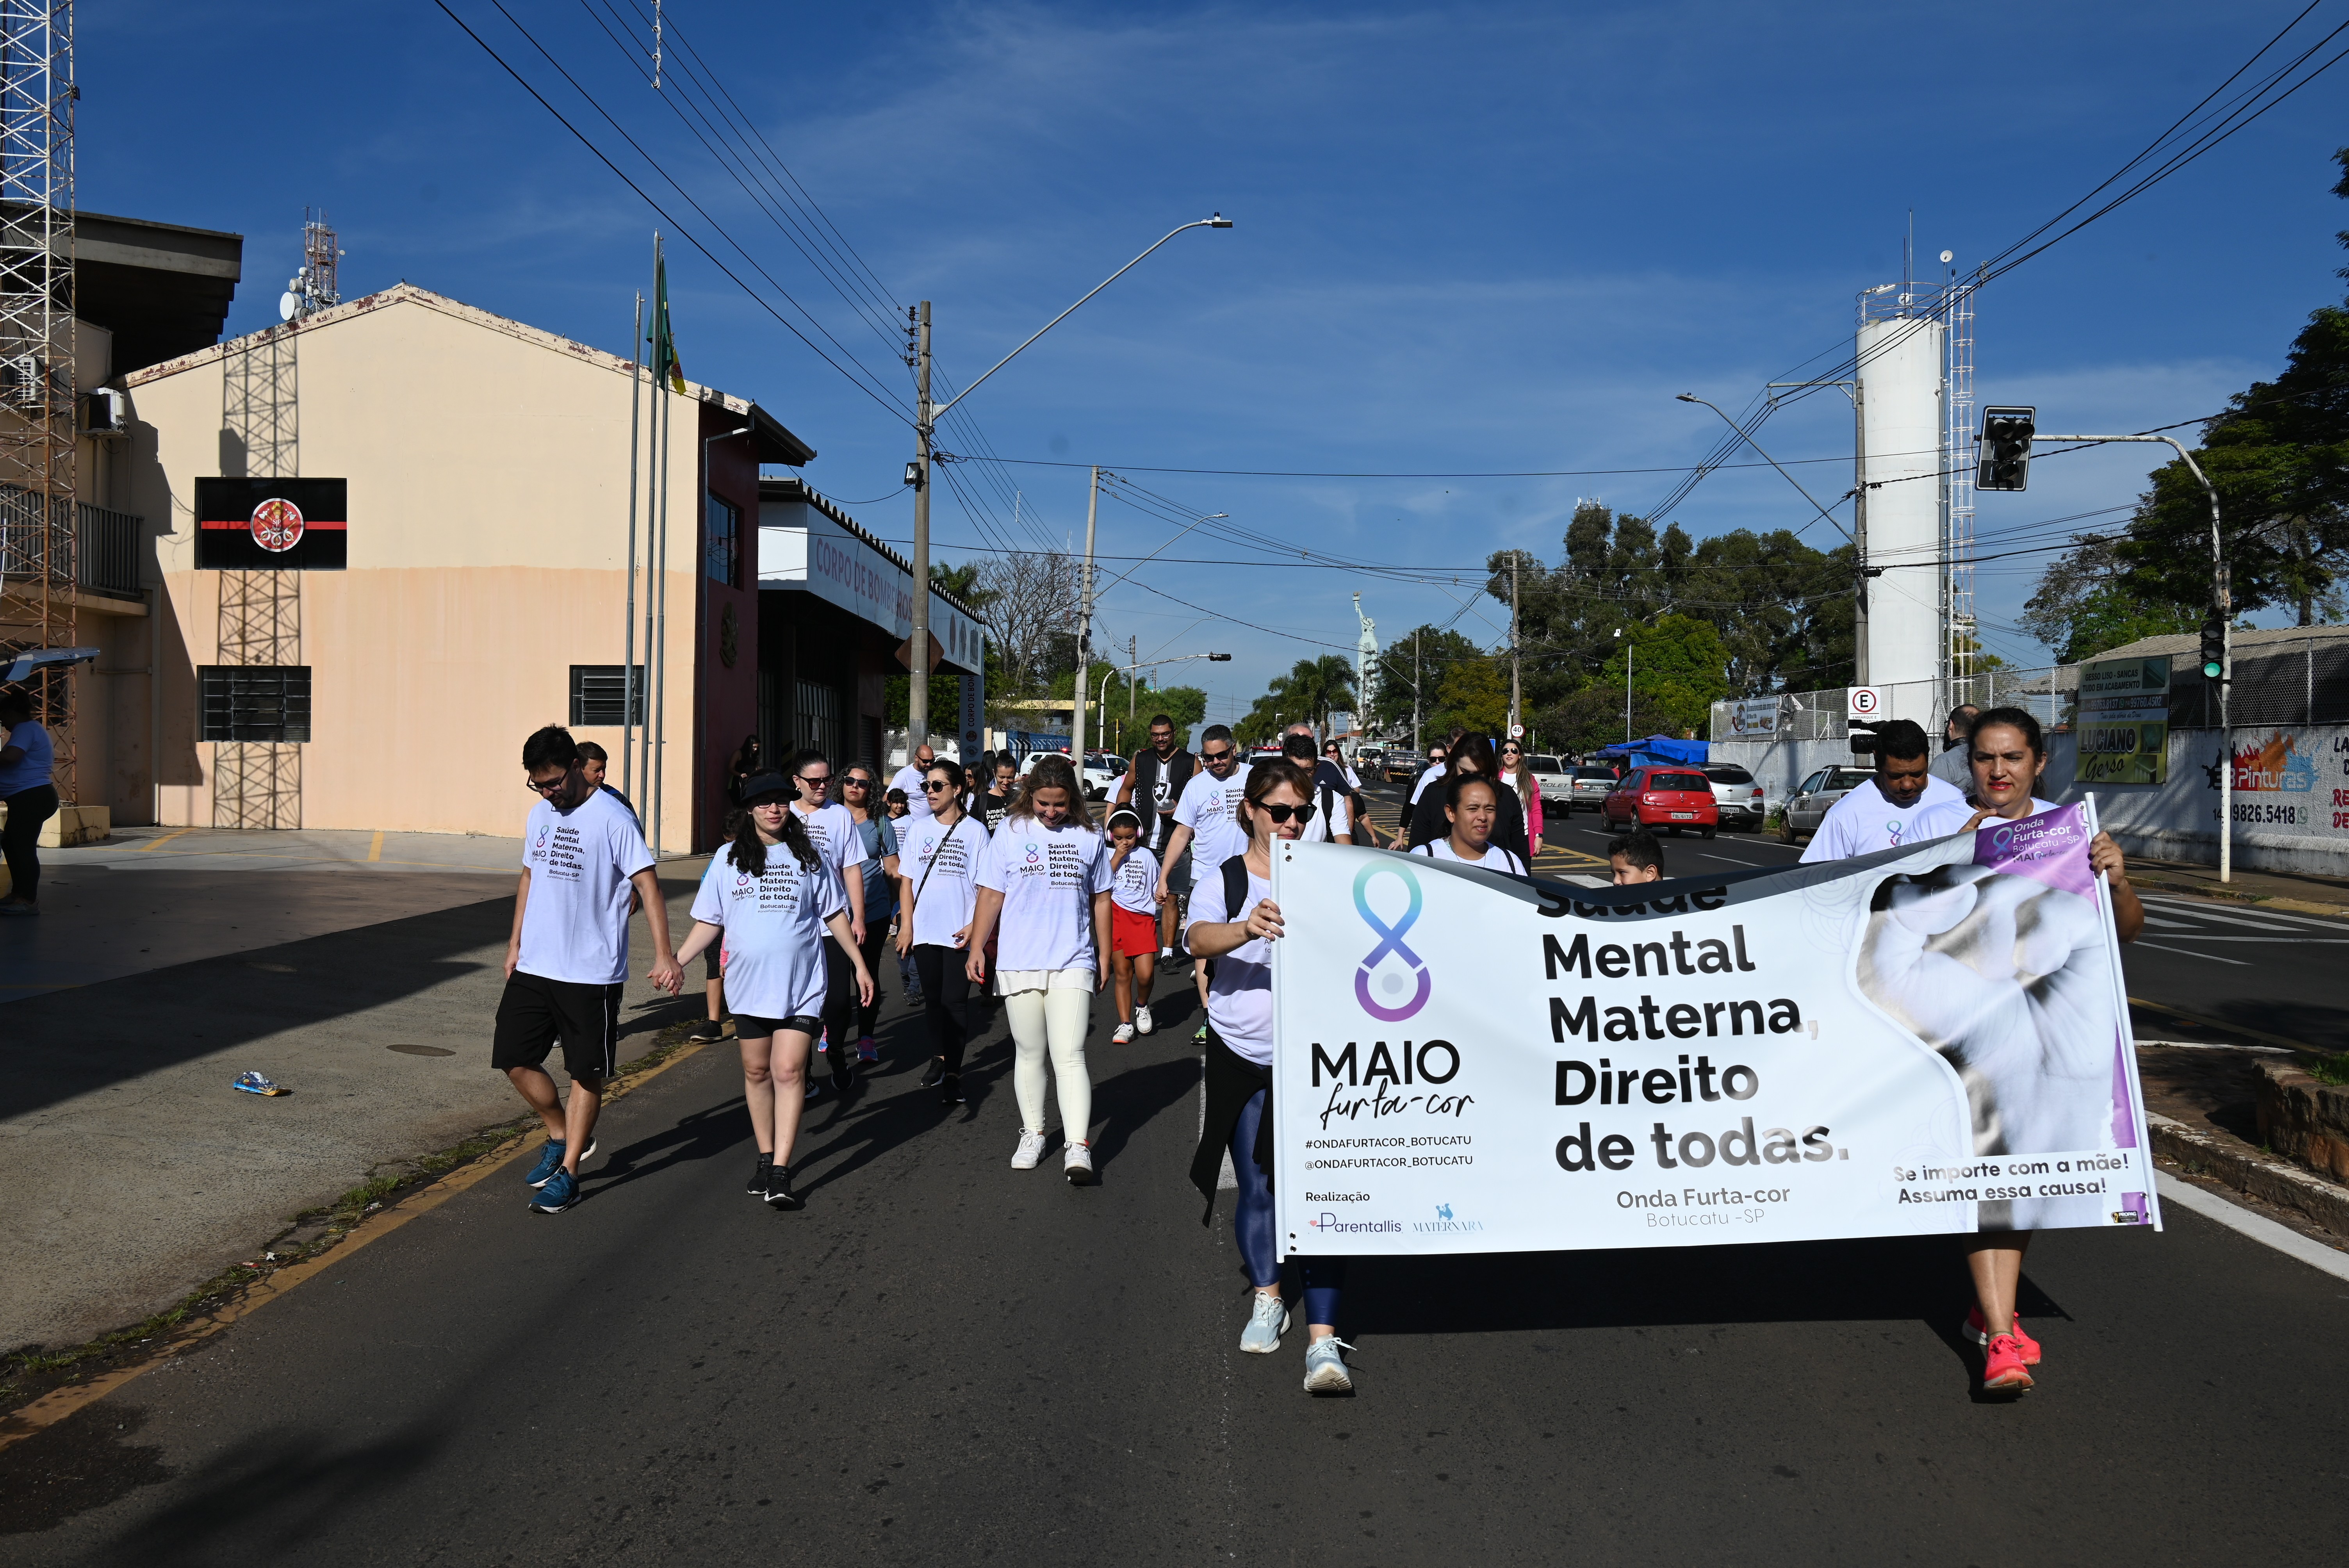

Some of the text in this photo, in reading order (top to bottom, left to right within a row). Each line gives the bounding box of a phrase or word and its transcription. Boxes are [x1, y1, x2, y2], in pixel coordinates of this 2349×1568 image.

[816, 538, 913, 623] CORPO DE BOMBEIROS
[2085, 672, 2101, 681] GESSO
[2102, 671, 2113, 680] LISO
[2117, 669, 2138, 679] SANCAS
[2083, 681, 2140, 692] TUDO EM ACABAMENTO
[968, 693, 975, 701] DE
[1860, 695, 1868, 707] E
[2130, 696, 2162, 708] 99760.4502
[2080, 727, 2136, 753] LUCIANO
[2238, 766, 2307, 788] Pinturas
[2230, 804, 2295, 824] 9826.5418
[556, 827, 579, 835] Saúde
[2014, 819, 2044, 832] Onda
[554, 834, 579, 844] Mental
[2013, 826, 2071, 843] Furta-cor
[552, 843, 585, 855] Materna,
[2013, 840, 2058, 852] Botucatu
[551, 850, 574, 860] Direito
[1050, 856, 1085, 865] Materna,
[560, 860, 584, 870] todas.
[1020, 865, 1044, 873] MAIO
[549, 869, 579, 878] Botucatu-SP
[1022, 870, 1046, 879] furta-cor
[1064, 871, 1084, 879] todas.
[760, 878, 800, 886] Materna,
[732, 887, 754, 898] MAIO
[774, 894, 799, 902] todas.
[1543, 924, 1756, 980] Mental
[1549, 995, 1818, 1043] Materna,
[1312, 1039, 1460, 1087] MAIO
[1555, 1054, 1759, 1105] Direito
[1320, 1078, 1475, 1130] furta-cor
[1305, 1135, 1472, 1149] #ONDAFURTACOR_BOTUCATU
[1556, 1116, 1849, 1172] de todas.
[1305, 1155, 1473, 1170] @ONDAFURTACOR_BOTUCATU
[1893, 1153, 2129, 1183] Se importe com a mãe!
[1305, 1191, 1370, 1203] Realização
[1898, 1178, 2107, 1204] Assuma essa causa!
[1617, 1187, 1790, 1208] Onda Furta-cor
[1316, 1213, 1401, 1232] Parentallis
[1647, 1211, 1729, 1227] Botucatu
[1413, 1221, 1483, 1232] MATERNARA
